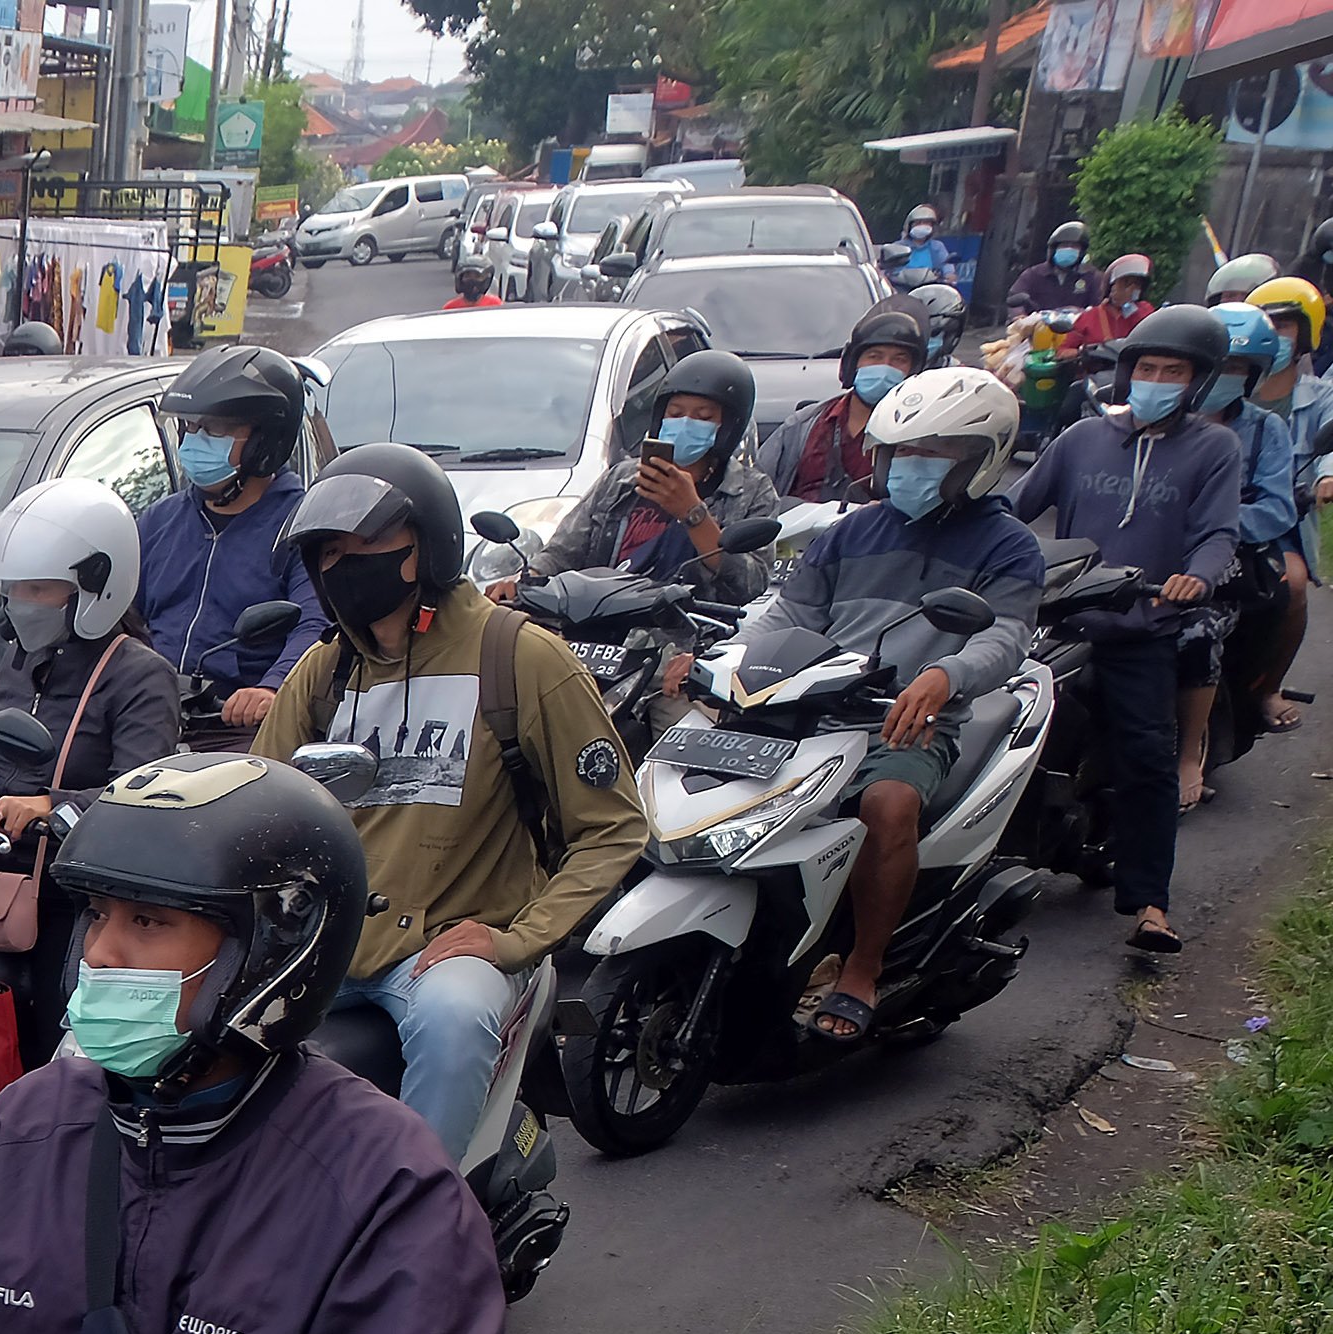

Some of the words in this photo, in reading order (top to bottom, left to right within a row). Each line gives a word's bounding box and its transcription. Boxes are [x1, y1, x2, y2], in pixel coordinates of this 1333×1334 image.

[592, 644, 627, 662] FBZ
[663, 730, 694, 745] DK
[697, 731, 754, 752] 6084
[817, 834, 856, 866] HONDA
